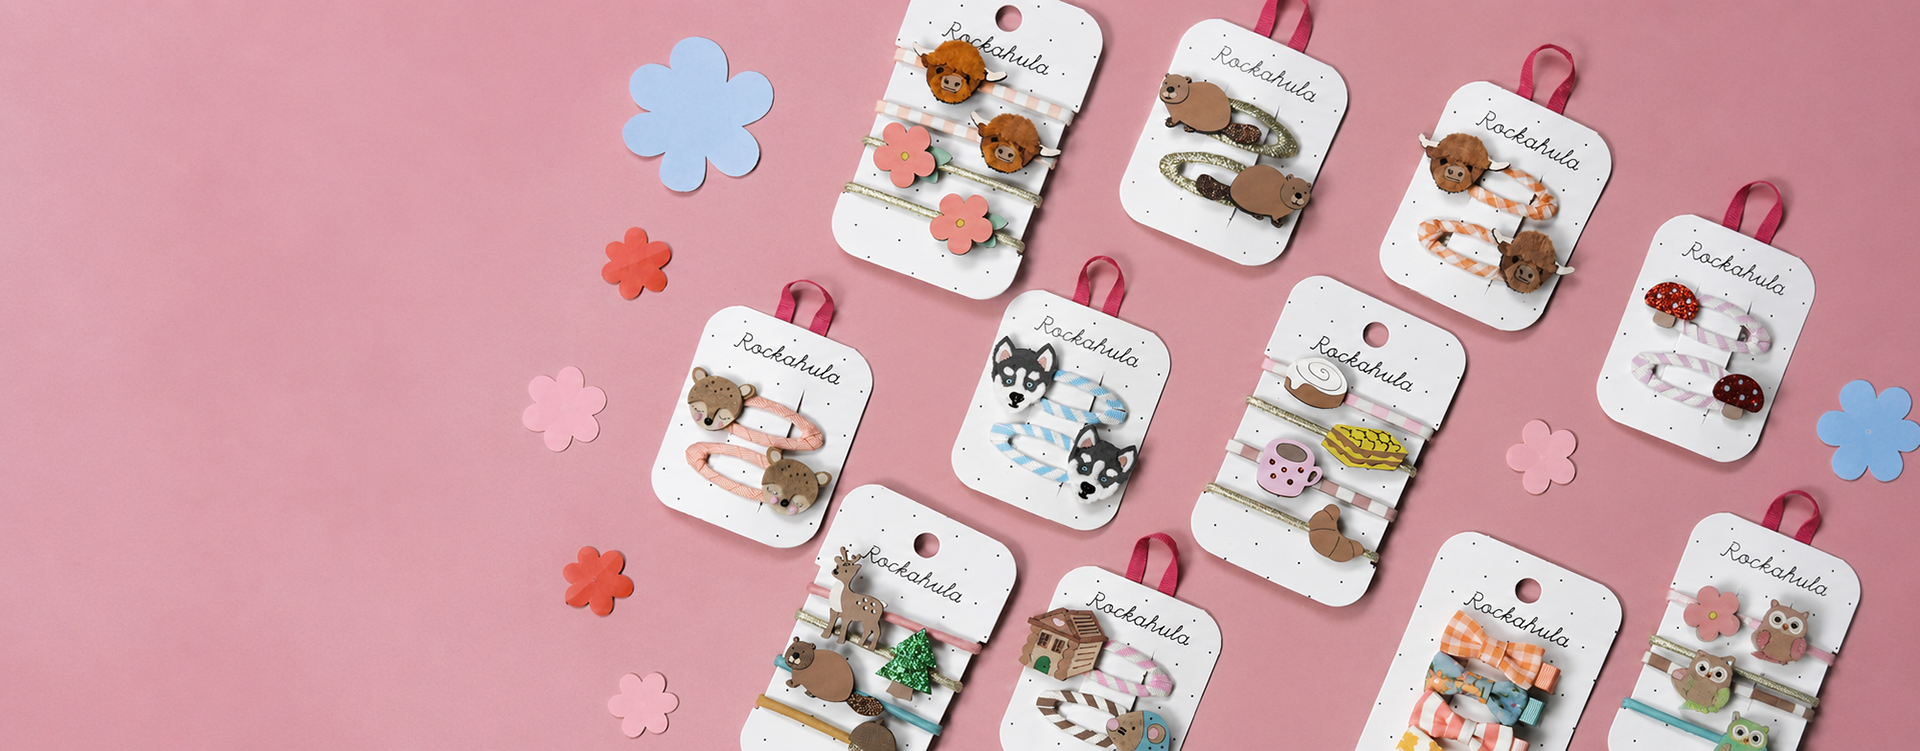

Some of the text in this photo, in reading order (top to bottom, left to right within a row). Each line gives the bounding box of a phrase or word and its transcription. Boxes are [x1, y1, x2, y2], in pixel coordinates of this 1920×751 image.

[1211, 46, 1317, 102] Rockahula
[1476, 110, 1580, 171] Rockahula
[1682, 241, 1786, 295] Rockahula
[734, 332, 841, 385] Rockahula
[1034, 315, 1141, 368] Rockahula
[1310, 335, 1414, 393] Rockahula
[861, 545, 963, 604] Rockahula
[1720, 541, 1828, 597] Rockahula
[1086, 591, 1190, 646] Rockahula
[1464, 591, 1571, 648] Rockahula
